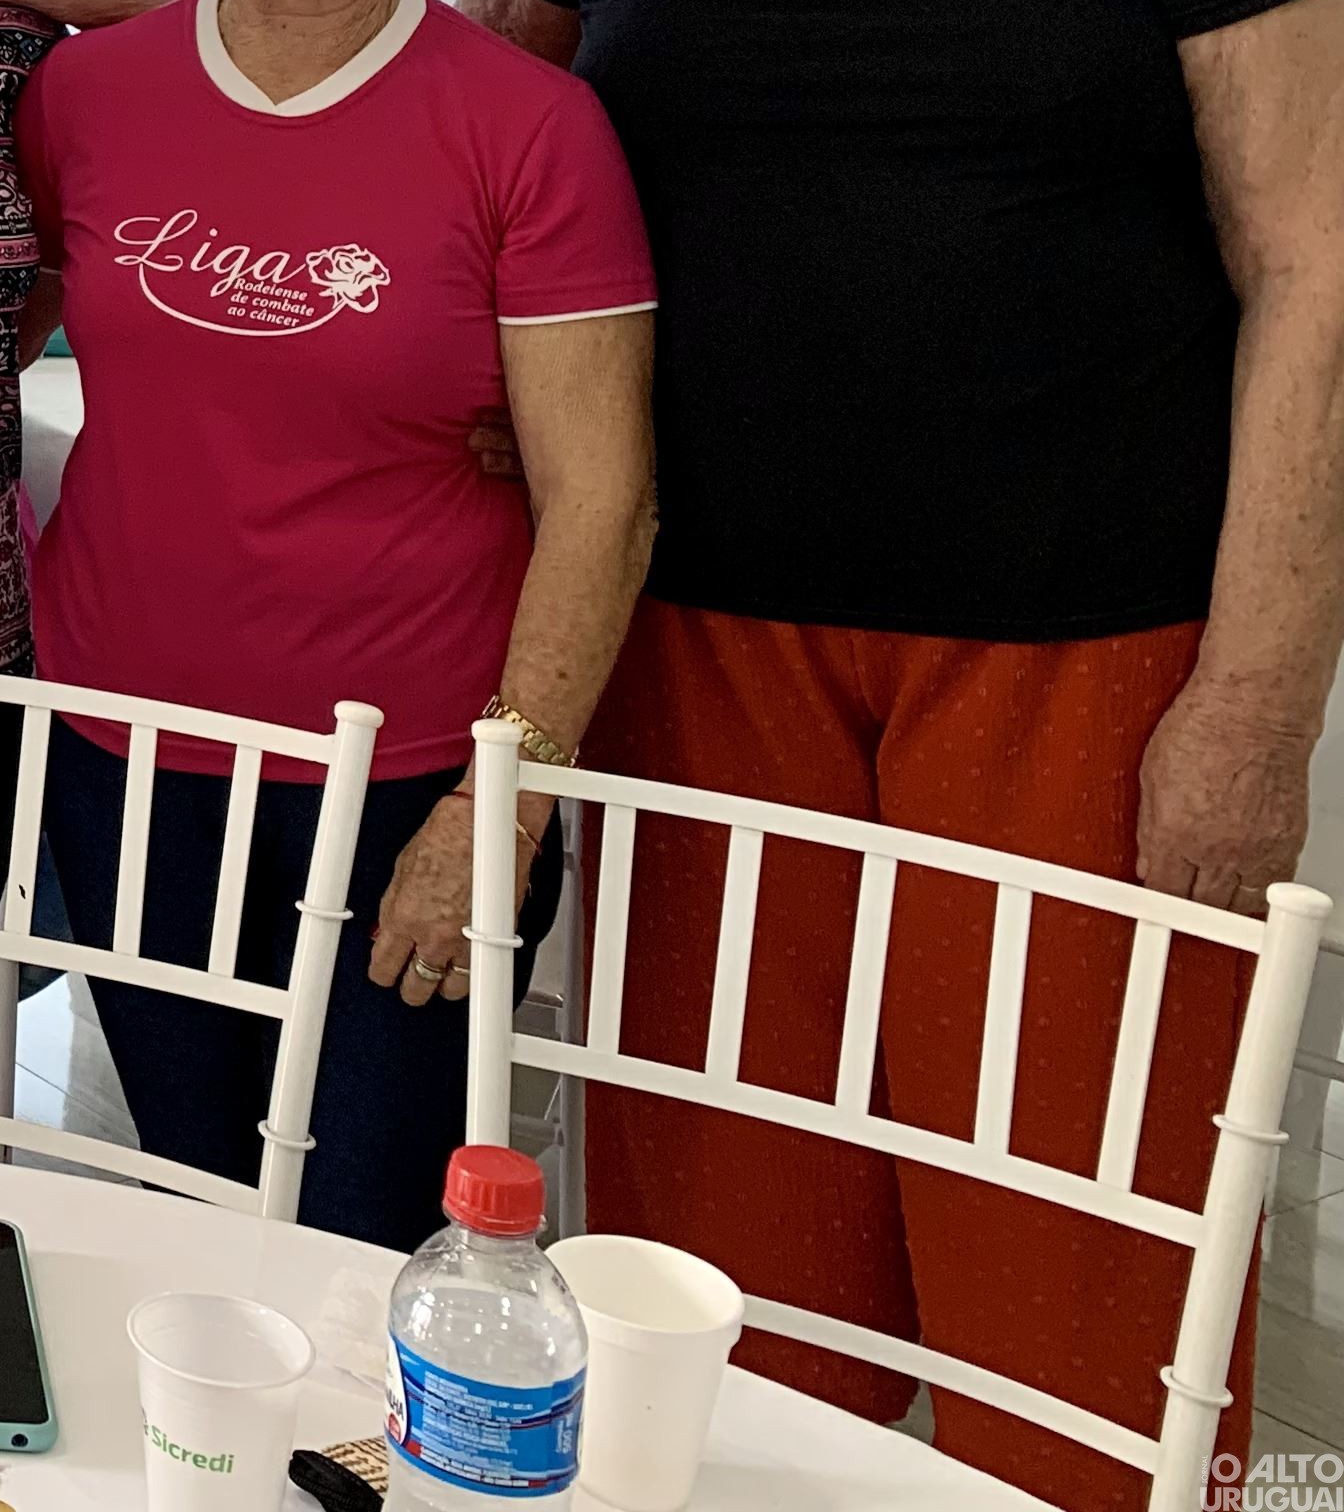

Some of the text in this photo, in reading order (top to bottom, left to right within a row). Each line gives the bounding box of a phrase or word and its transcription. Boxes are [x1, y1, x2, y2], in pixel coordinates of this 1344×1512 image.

[114, 209, 307, 297] Liga
[234, 277, 308, 301] Rodeiense
[227, 306, 300, 328] ao câncer
[230, 291, 315, 317] de combate
[151, 1425, 234, 1473] Sicredi
